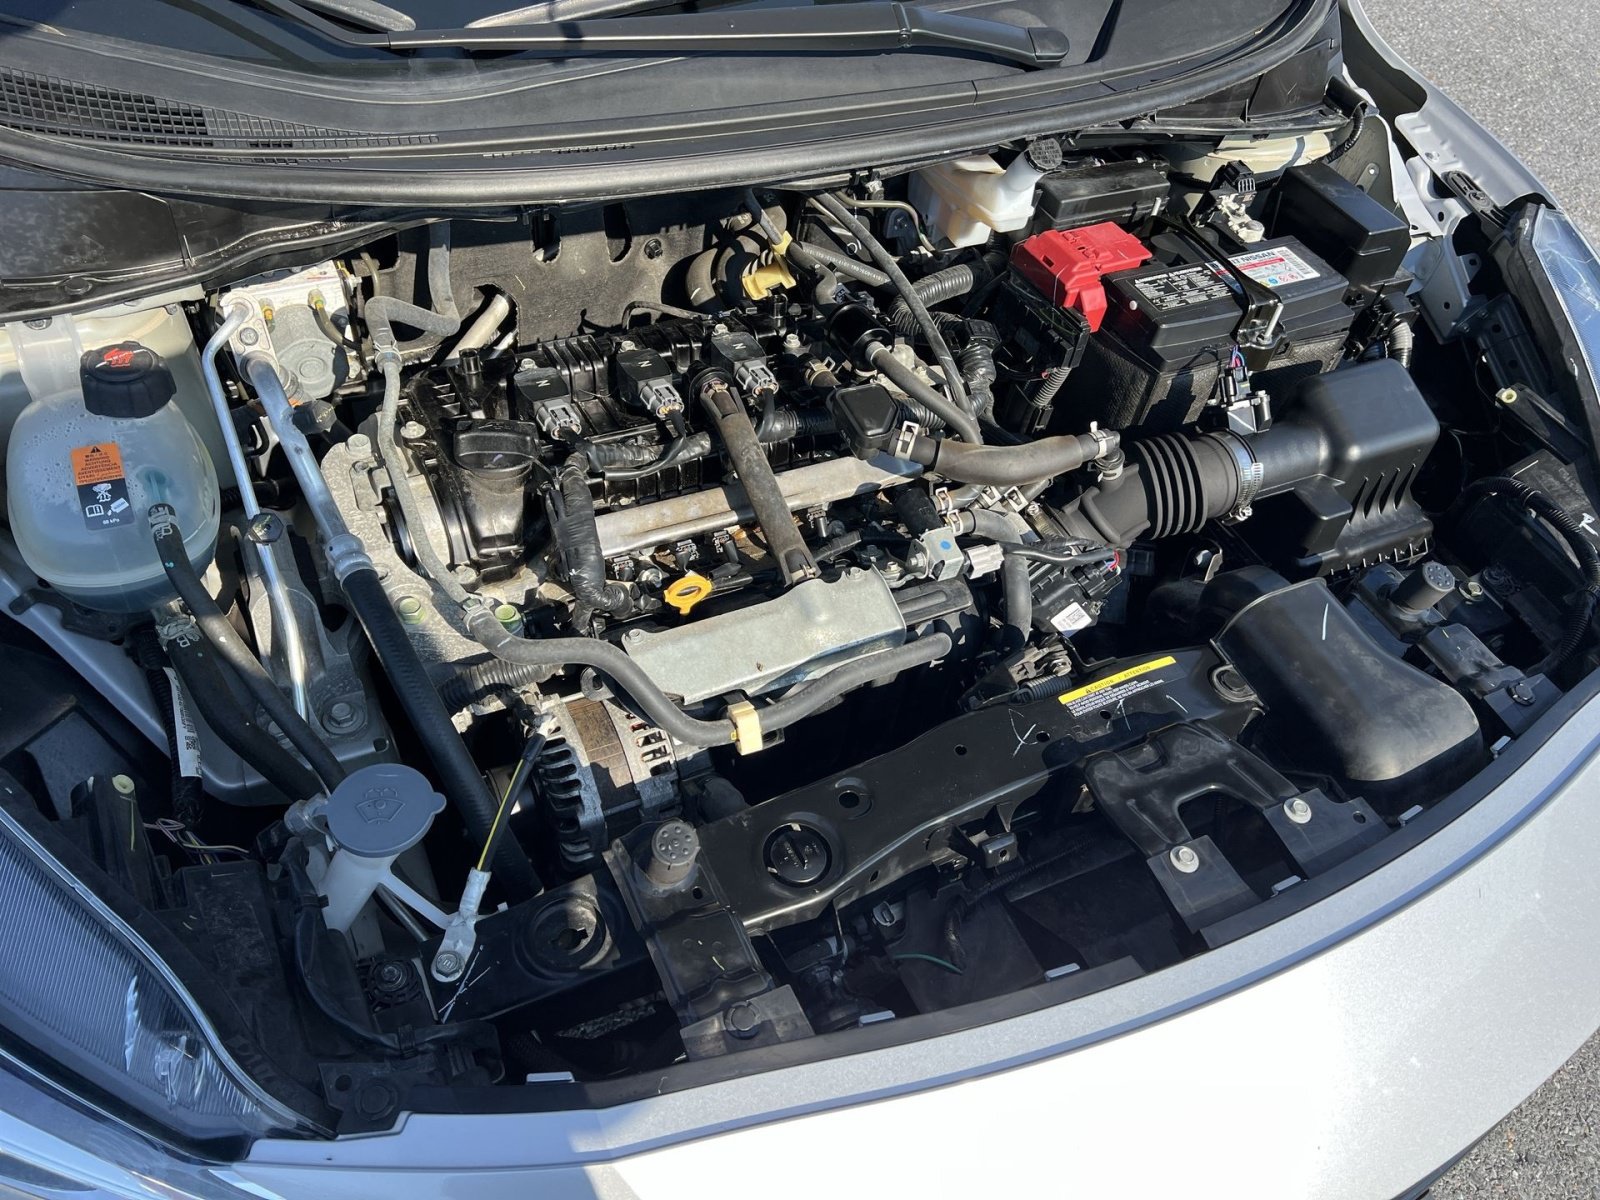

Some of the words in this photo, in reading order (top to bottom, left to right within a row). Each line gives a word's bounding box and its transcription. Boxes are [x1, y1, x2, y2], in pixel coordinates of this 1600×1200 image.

[1241, 251, 1276, 262] NISSAN
[1090, 679, 1114, 691] CAUTION
[1123, 665, 1151, 678] ATTENTION
